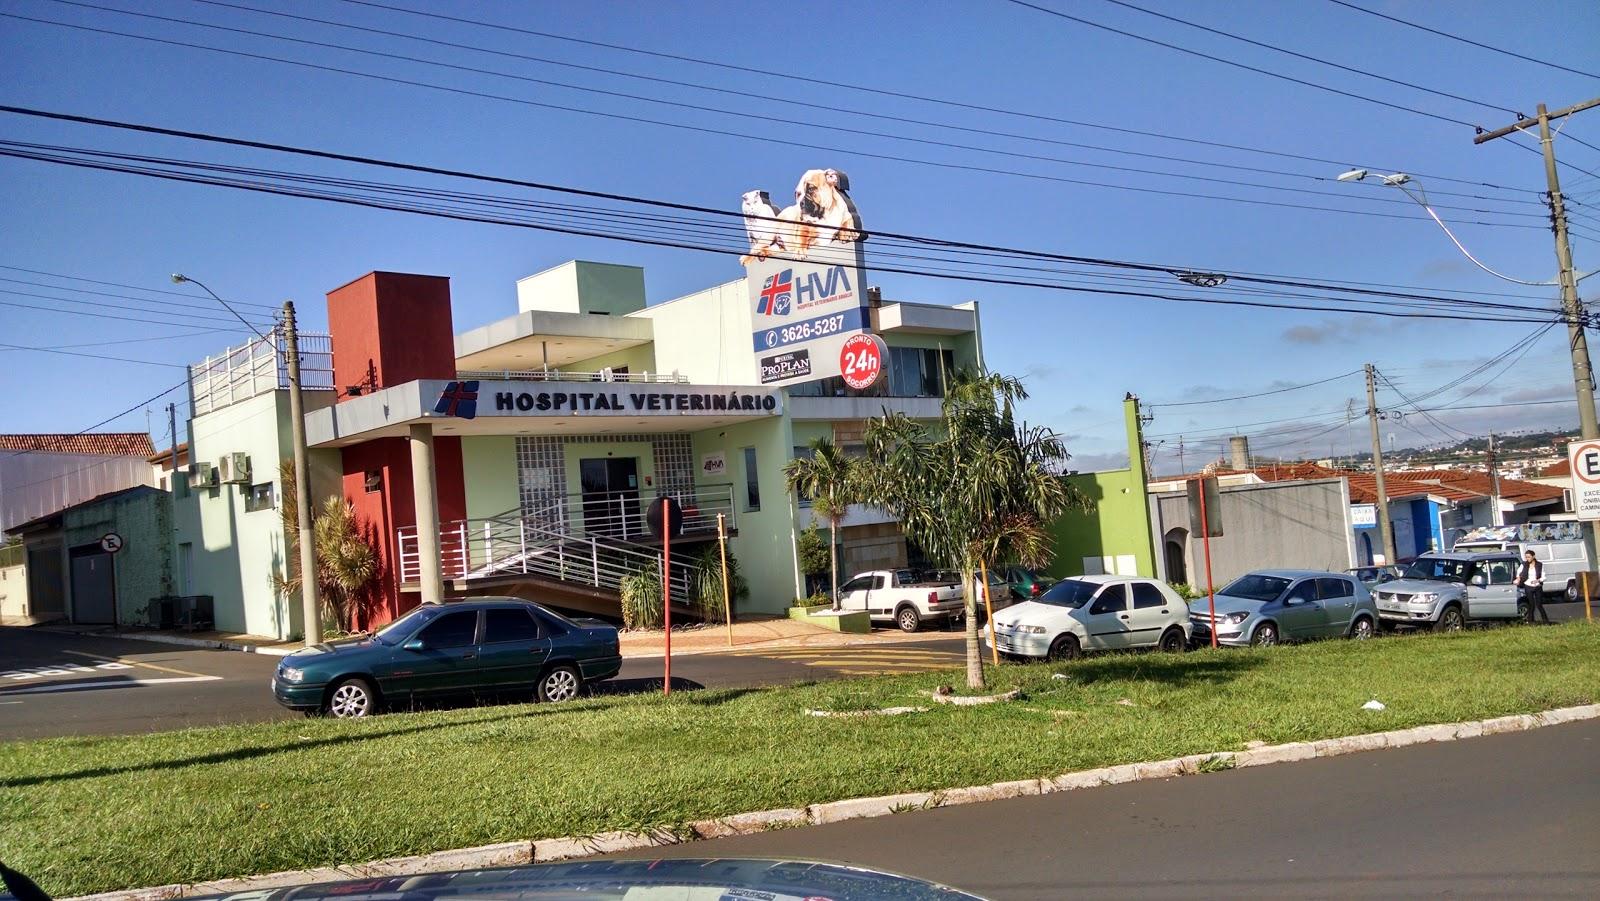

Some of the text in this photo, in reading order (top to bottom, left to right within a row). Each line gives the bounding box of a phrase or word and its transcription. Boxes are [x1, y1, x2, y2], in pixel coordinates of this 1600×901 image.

[796, 266, 851, 304] HVA
[781, 315, 844, 343] 3626-5287
[846, 335, 872, 349] PRONTO
[845, 350, 877, 375] 24h
[847, 371, 876, 387] SOCORRO
[496, 391, 776, 411] HOSPITAL VETERINÁRIO
